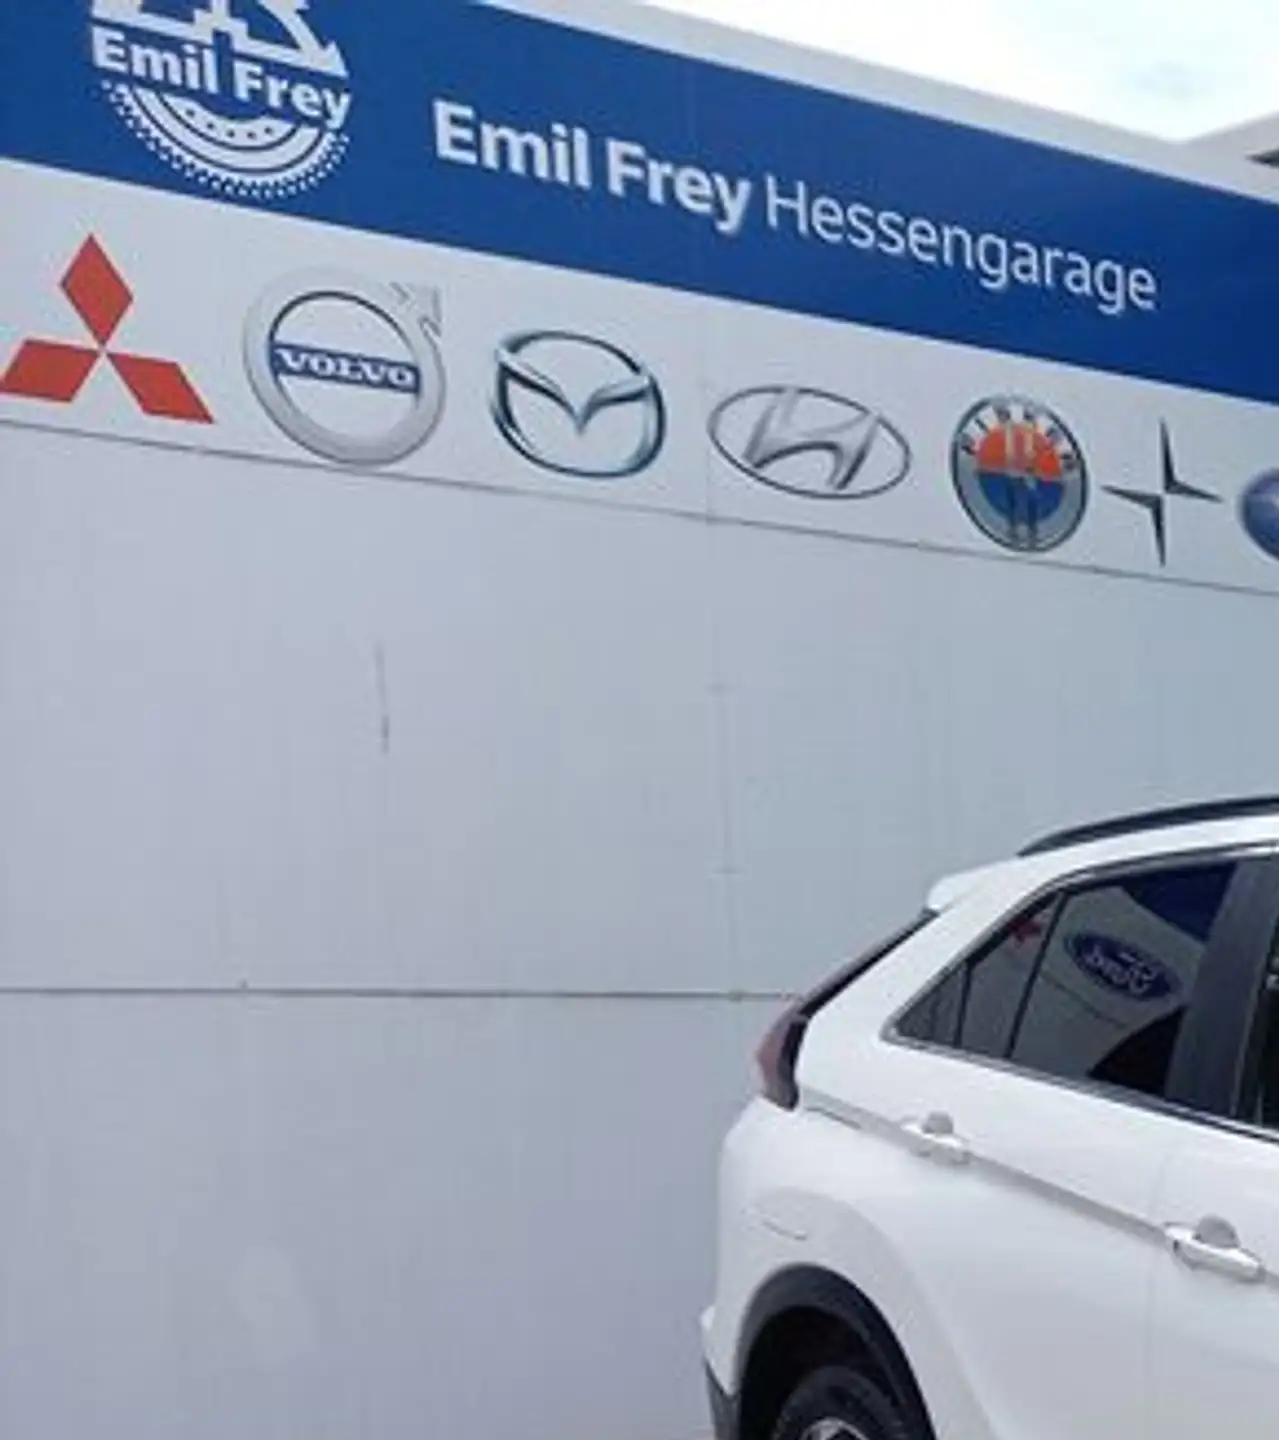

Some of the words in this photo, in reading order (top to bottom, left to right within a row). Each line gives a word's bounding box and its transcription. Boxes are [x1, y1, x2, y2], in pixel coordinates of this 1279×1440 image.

[91, 26, 217, 94] Emil
[232, 60, 351, 129] Frey
[434, 98, 592, 190] Emil
[606, 136, 750, 236] Frey
[765, 173, 1157, 316] Hessengarage
[274, 348, 415, 387] VOLVO
